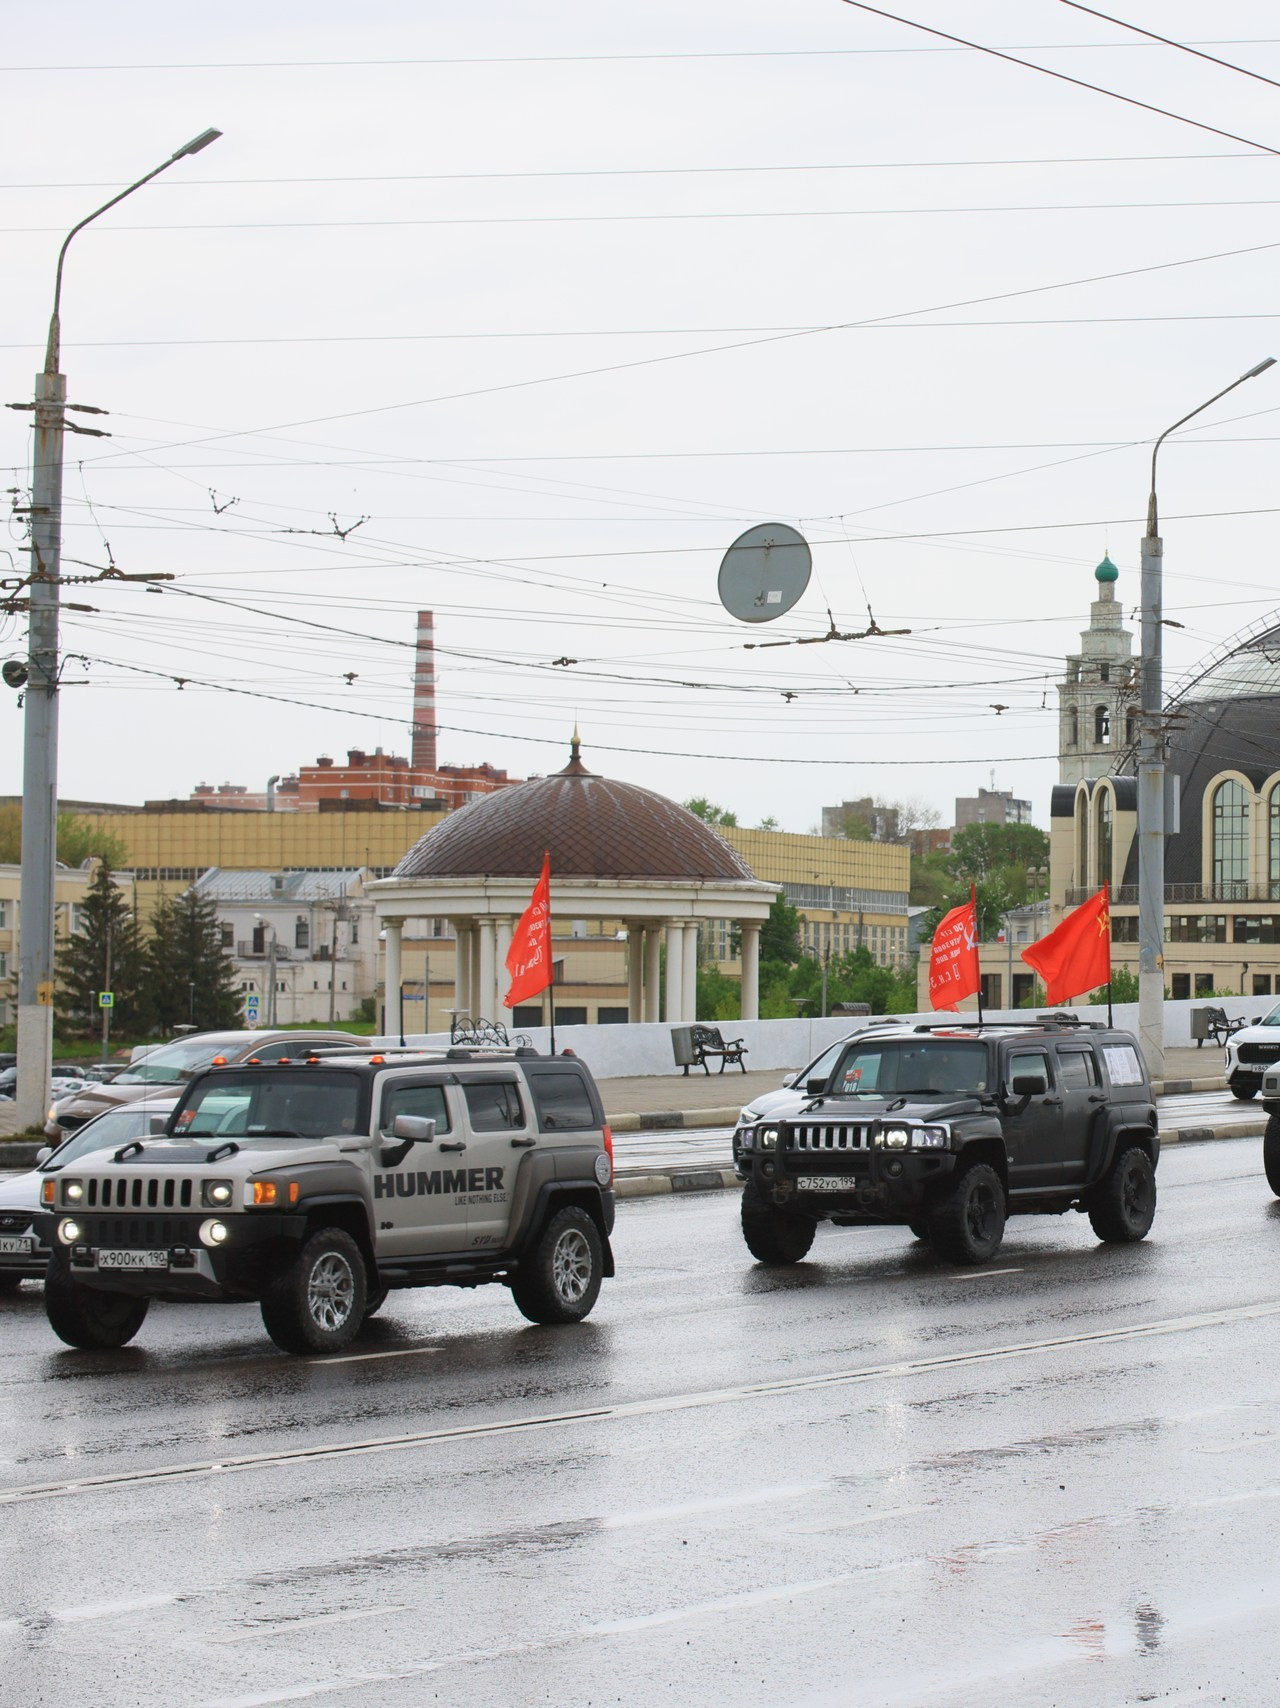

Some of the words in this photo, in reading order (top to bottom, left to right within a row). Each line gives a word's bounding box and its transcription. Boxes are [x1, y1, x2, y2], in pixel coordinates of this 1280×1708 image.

[374, 1167, 505, 1199] HUMMER
[800, 1177, 838, 1189] С752УО
[102, 1252, 146, 1267] Х900КК
[149, 1251, 165, 1262] 190
